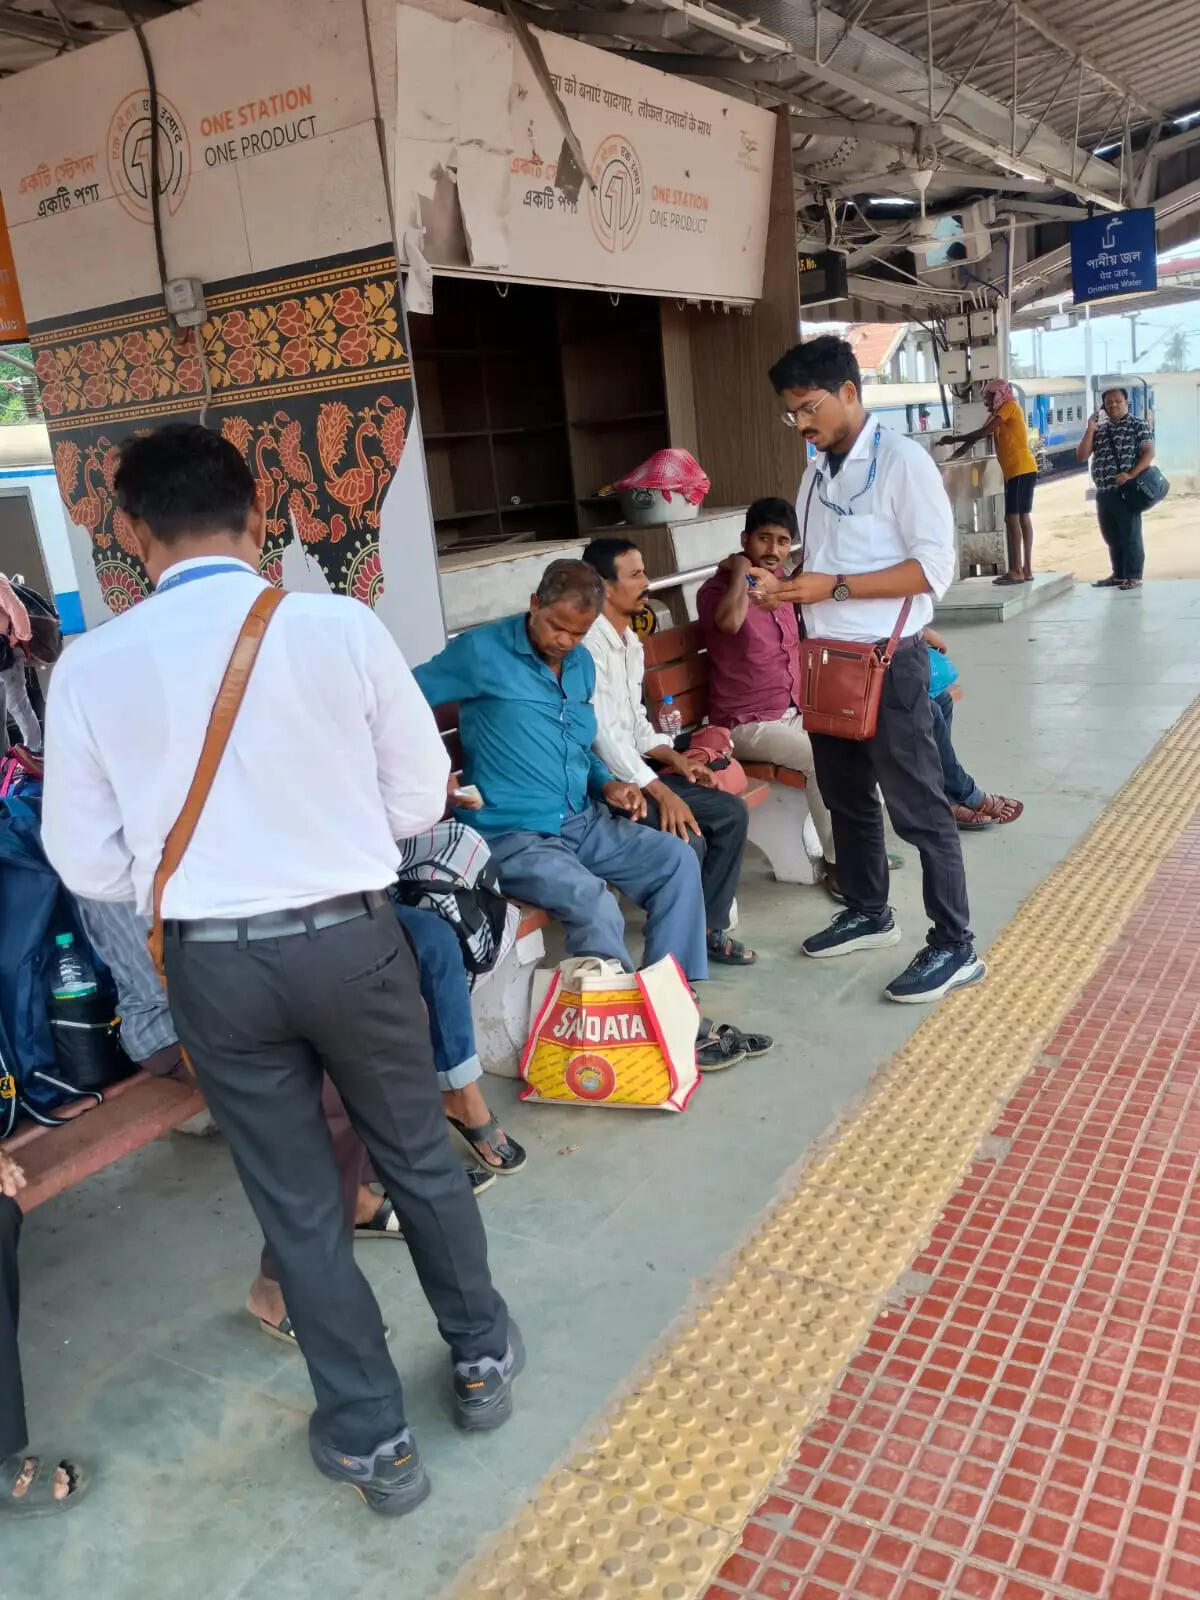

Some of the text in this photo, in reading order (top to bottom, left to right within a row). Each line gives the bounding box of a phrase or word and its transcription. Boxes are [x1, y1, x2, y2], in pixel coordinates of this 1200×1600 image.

[564, 74, 576, 97] को
[200, 84, 312, 136] ONE STATION
[205, 115, 316, 166] ONE PRODUCT
[37, 183, 100, 217] একটি পণ্য
[523, 185, 555, 210] একটি
[651, 185, 709, 212] ONE STATION
[649, 208, 708, 234] ONE PRODUCT
[1087, 251, 1142, 268] পানীয় জল
[1088, 279, 1142, 295] Drinking Water
